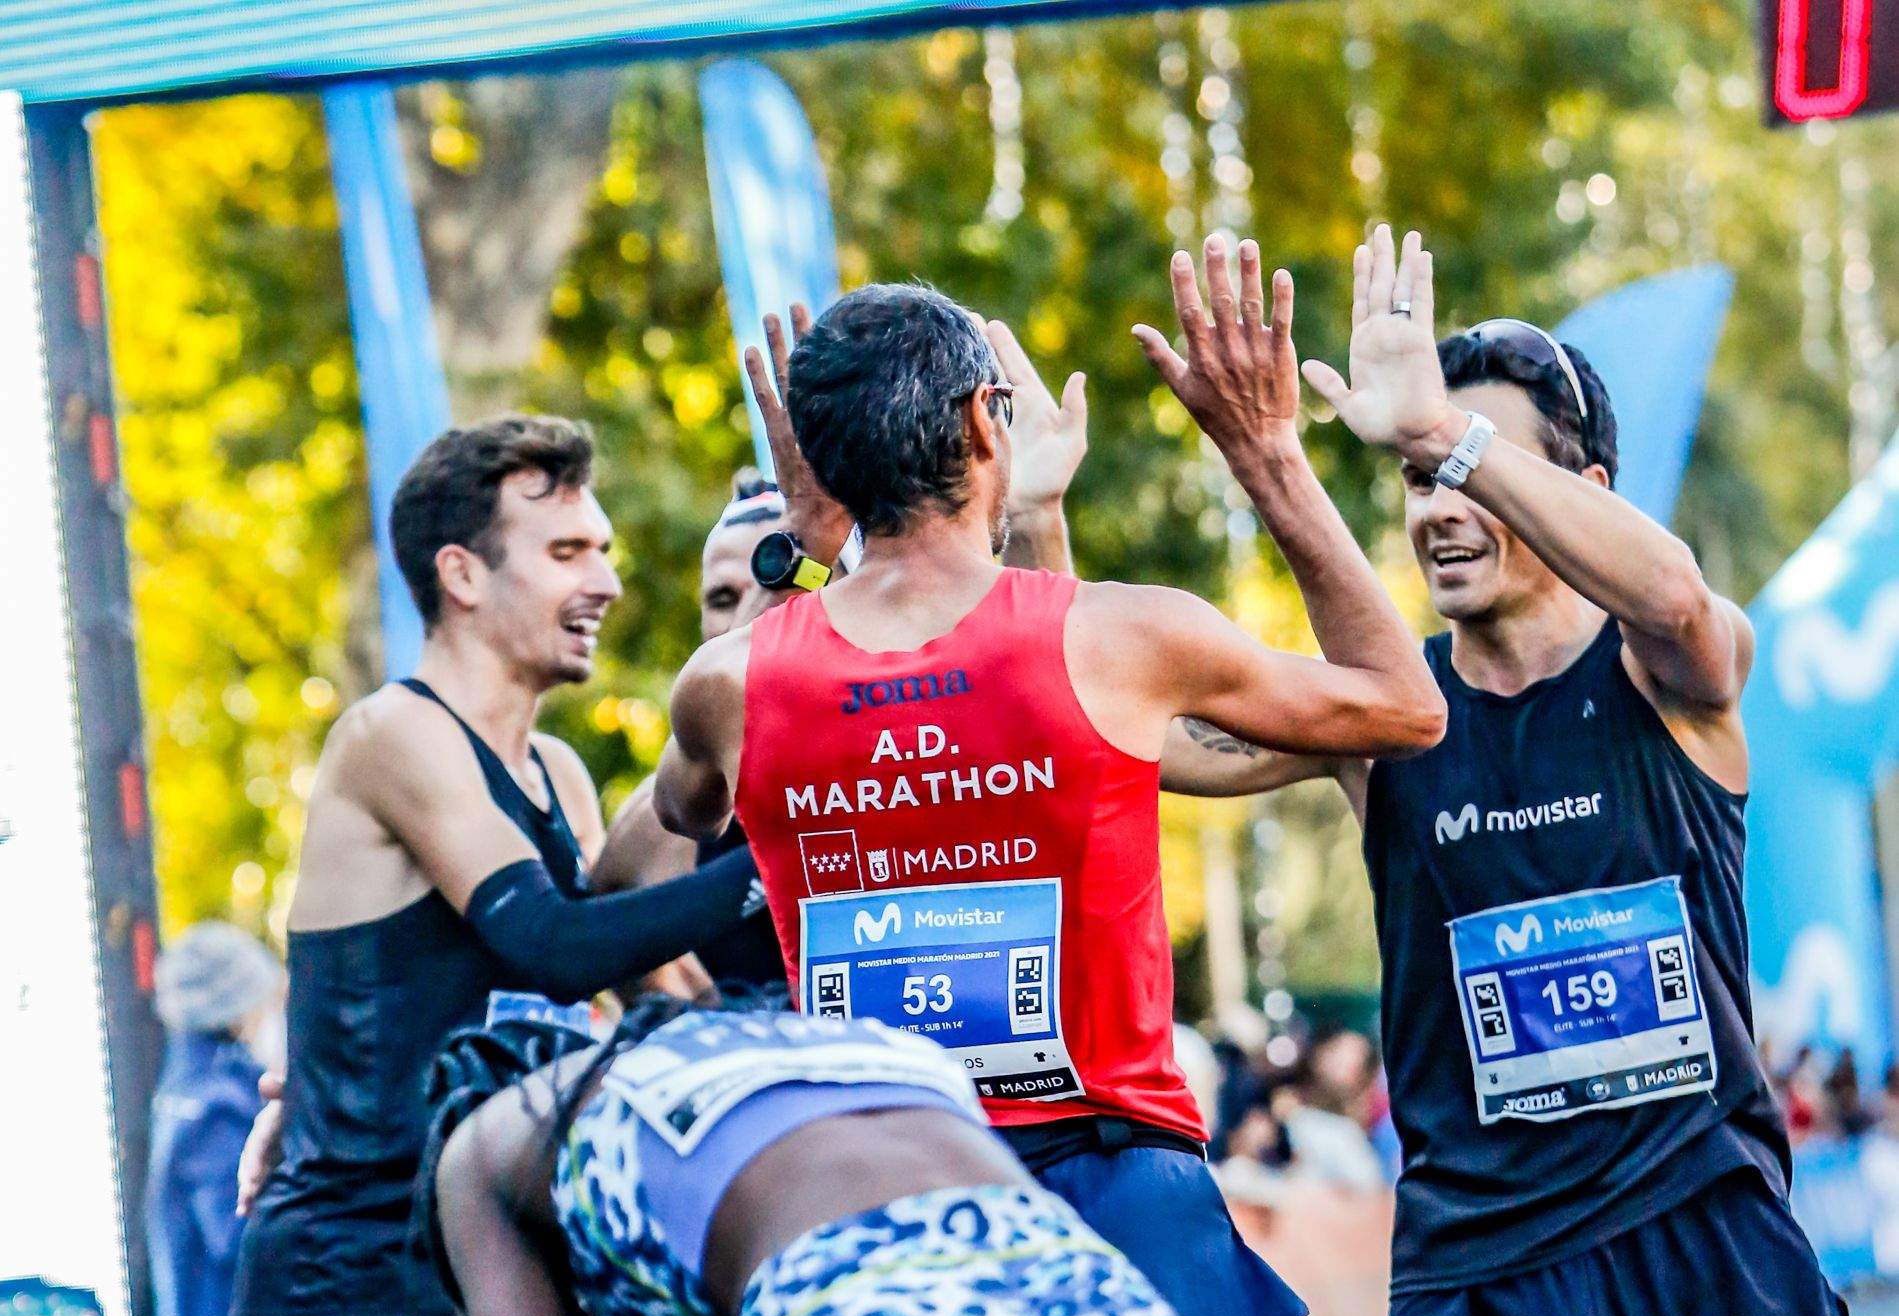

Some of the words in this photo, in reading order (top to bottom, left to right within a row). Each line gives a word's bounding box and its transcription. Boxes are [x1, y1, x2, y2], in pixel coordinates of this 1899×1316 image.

[870, 724, 960, 764] A.D.
[784, 756, 1055, 819] MARATHON
[1486, 792, 1602, 832] movistar
[903, 837, 1037, 875] MADRID
[914, 908, 1005, 928] Movistar
[1553, 908, 1634, 936] Movistar
[857, 959, 892, 968] MOVISTAR
[893, 956, 916, 964] MEDIO
[917, 953, 953, 963] MARATÓN
[954, 952, 984, 961] MADRID
[984, 950, 1000, 958] 2021
[1505, 964, 1539, 976] MOVISTAR
[902, 974, 953, 1016] 53
[1541, 969, 1618, 1017] 159
[925, 1022, 941, 1032] SUB
[941, 1021, 951, 1030] 1h
[1000, 1075, 1065, 1095] MADRID
[1644, 1061, 1703, 1087] MADRID
